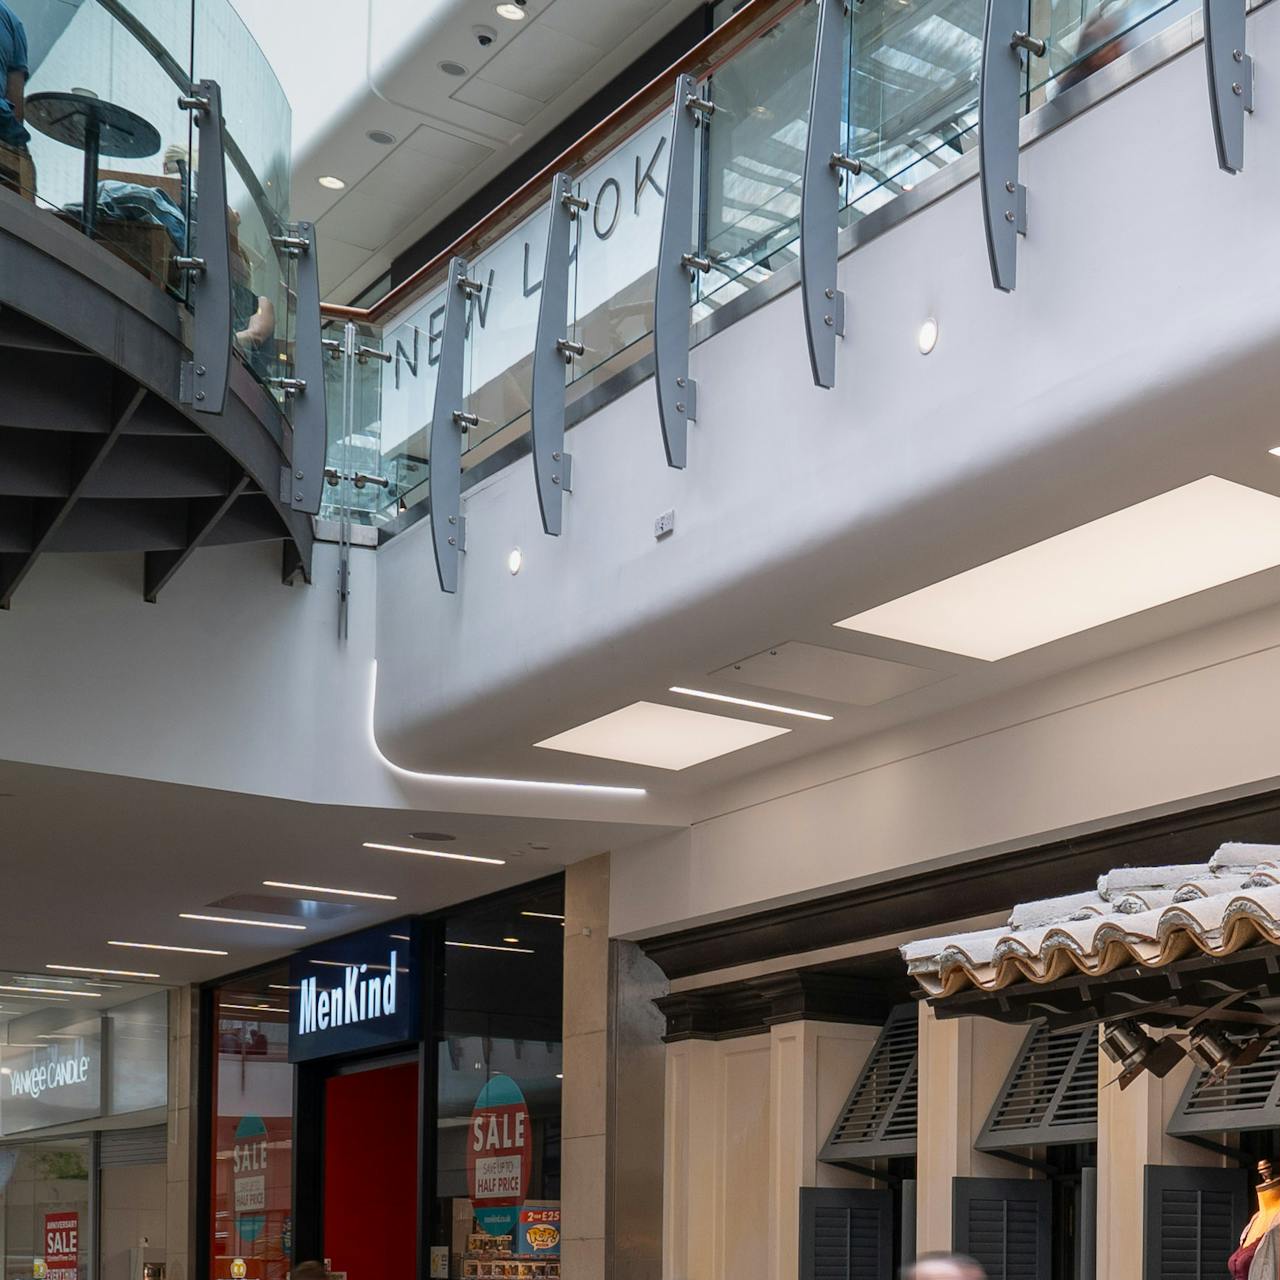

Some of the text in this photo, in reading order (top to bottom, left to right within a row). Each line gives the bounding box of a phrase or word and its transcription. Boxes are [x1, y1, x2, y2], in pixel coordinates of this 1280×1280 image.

[523, 136, 666, 297] LOK
[299, 950, 397, 1035] MenKind
[474, 1112, 525, 1152] SALE
[233, 1141, 268, 1173] SALE
[478, 1176, 519, 1193] HALF PRICE
[47, 1231, 77, 1253] SALE
